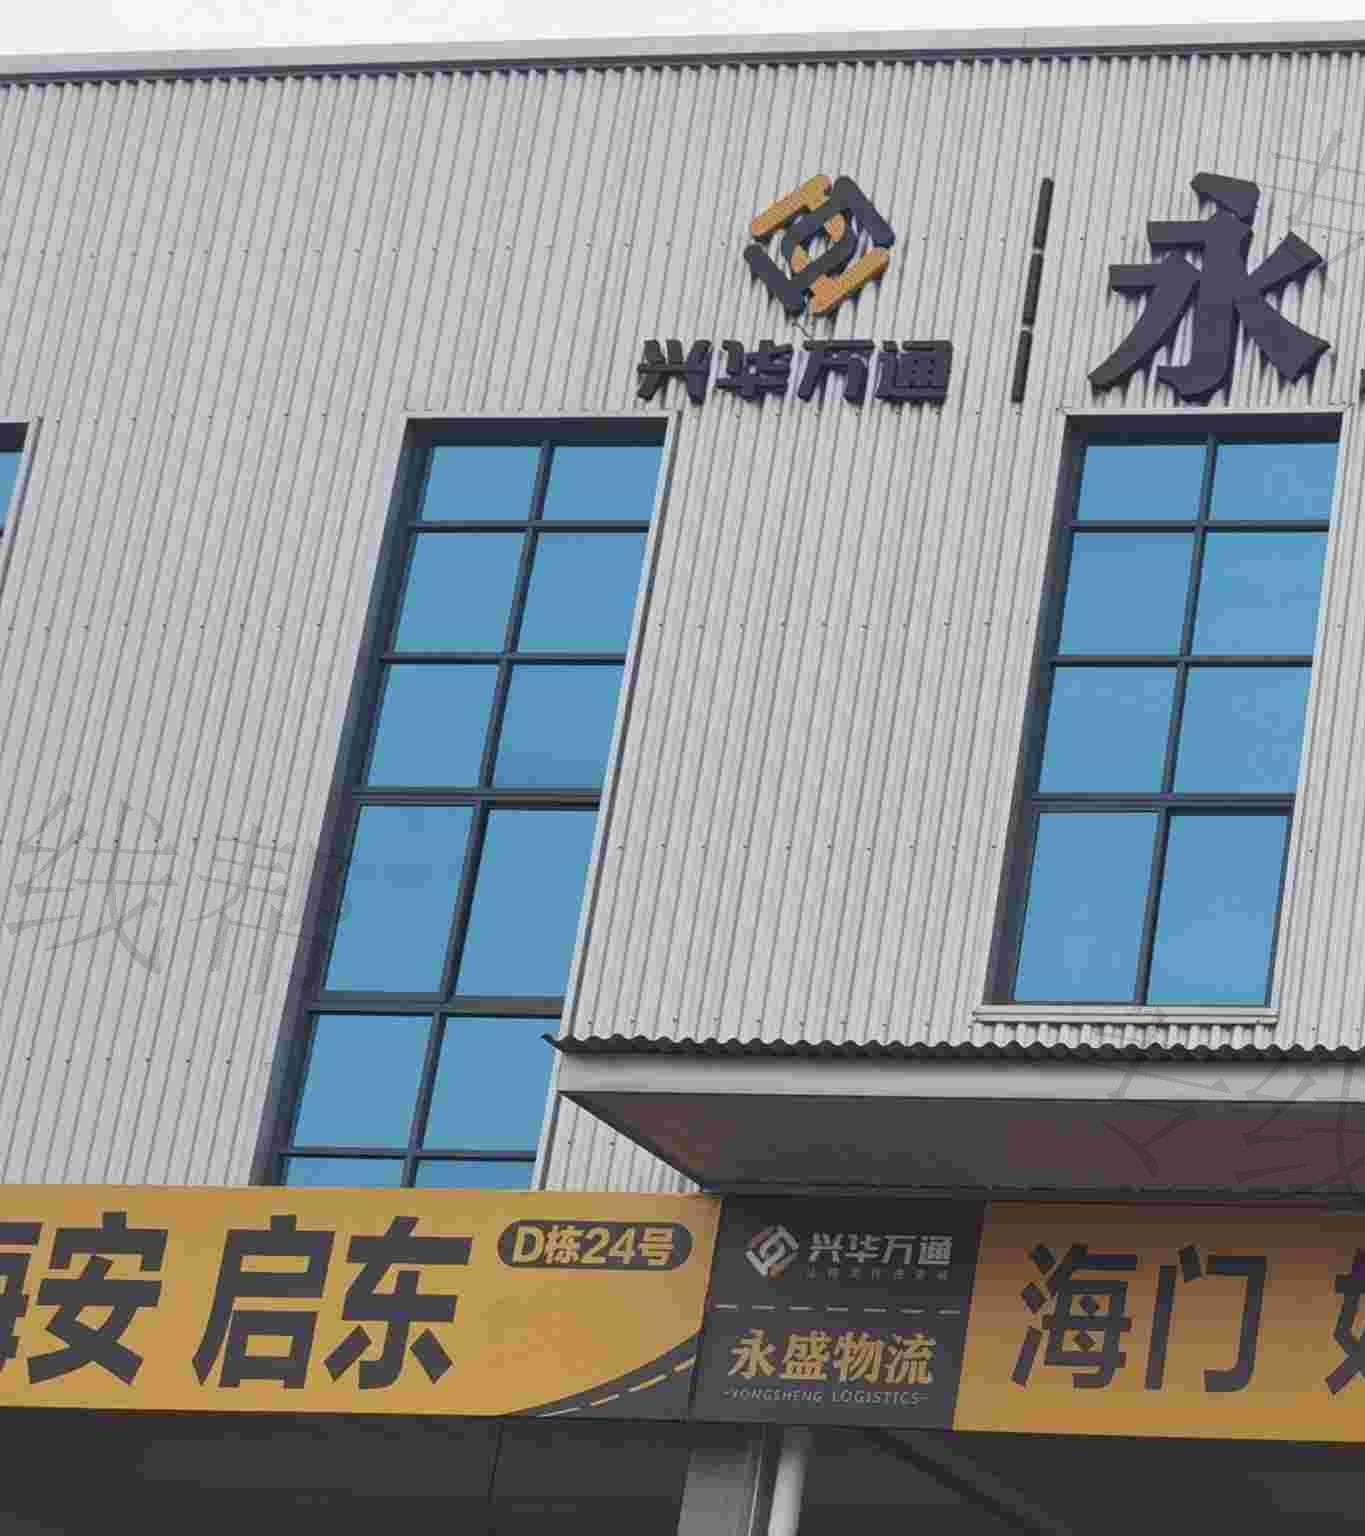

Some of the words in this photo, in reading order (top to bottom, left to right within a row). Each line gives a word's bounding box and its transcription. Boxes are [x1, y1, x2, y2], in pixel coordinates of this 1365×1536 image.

[637, 338, 954, 405] 兴华万通
[512, 1224, 680, 1269] D栋24号
[806, 1232, 954, 1264] 兴华万通
[193, 1215, 473, 1390] 启东
[1011, 1242, 1269, 1394] 海门
[726, 1327, 936, 1386] 永盛物流
